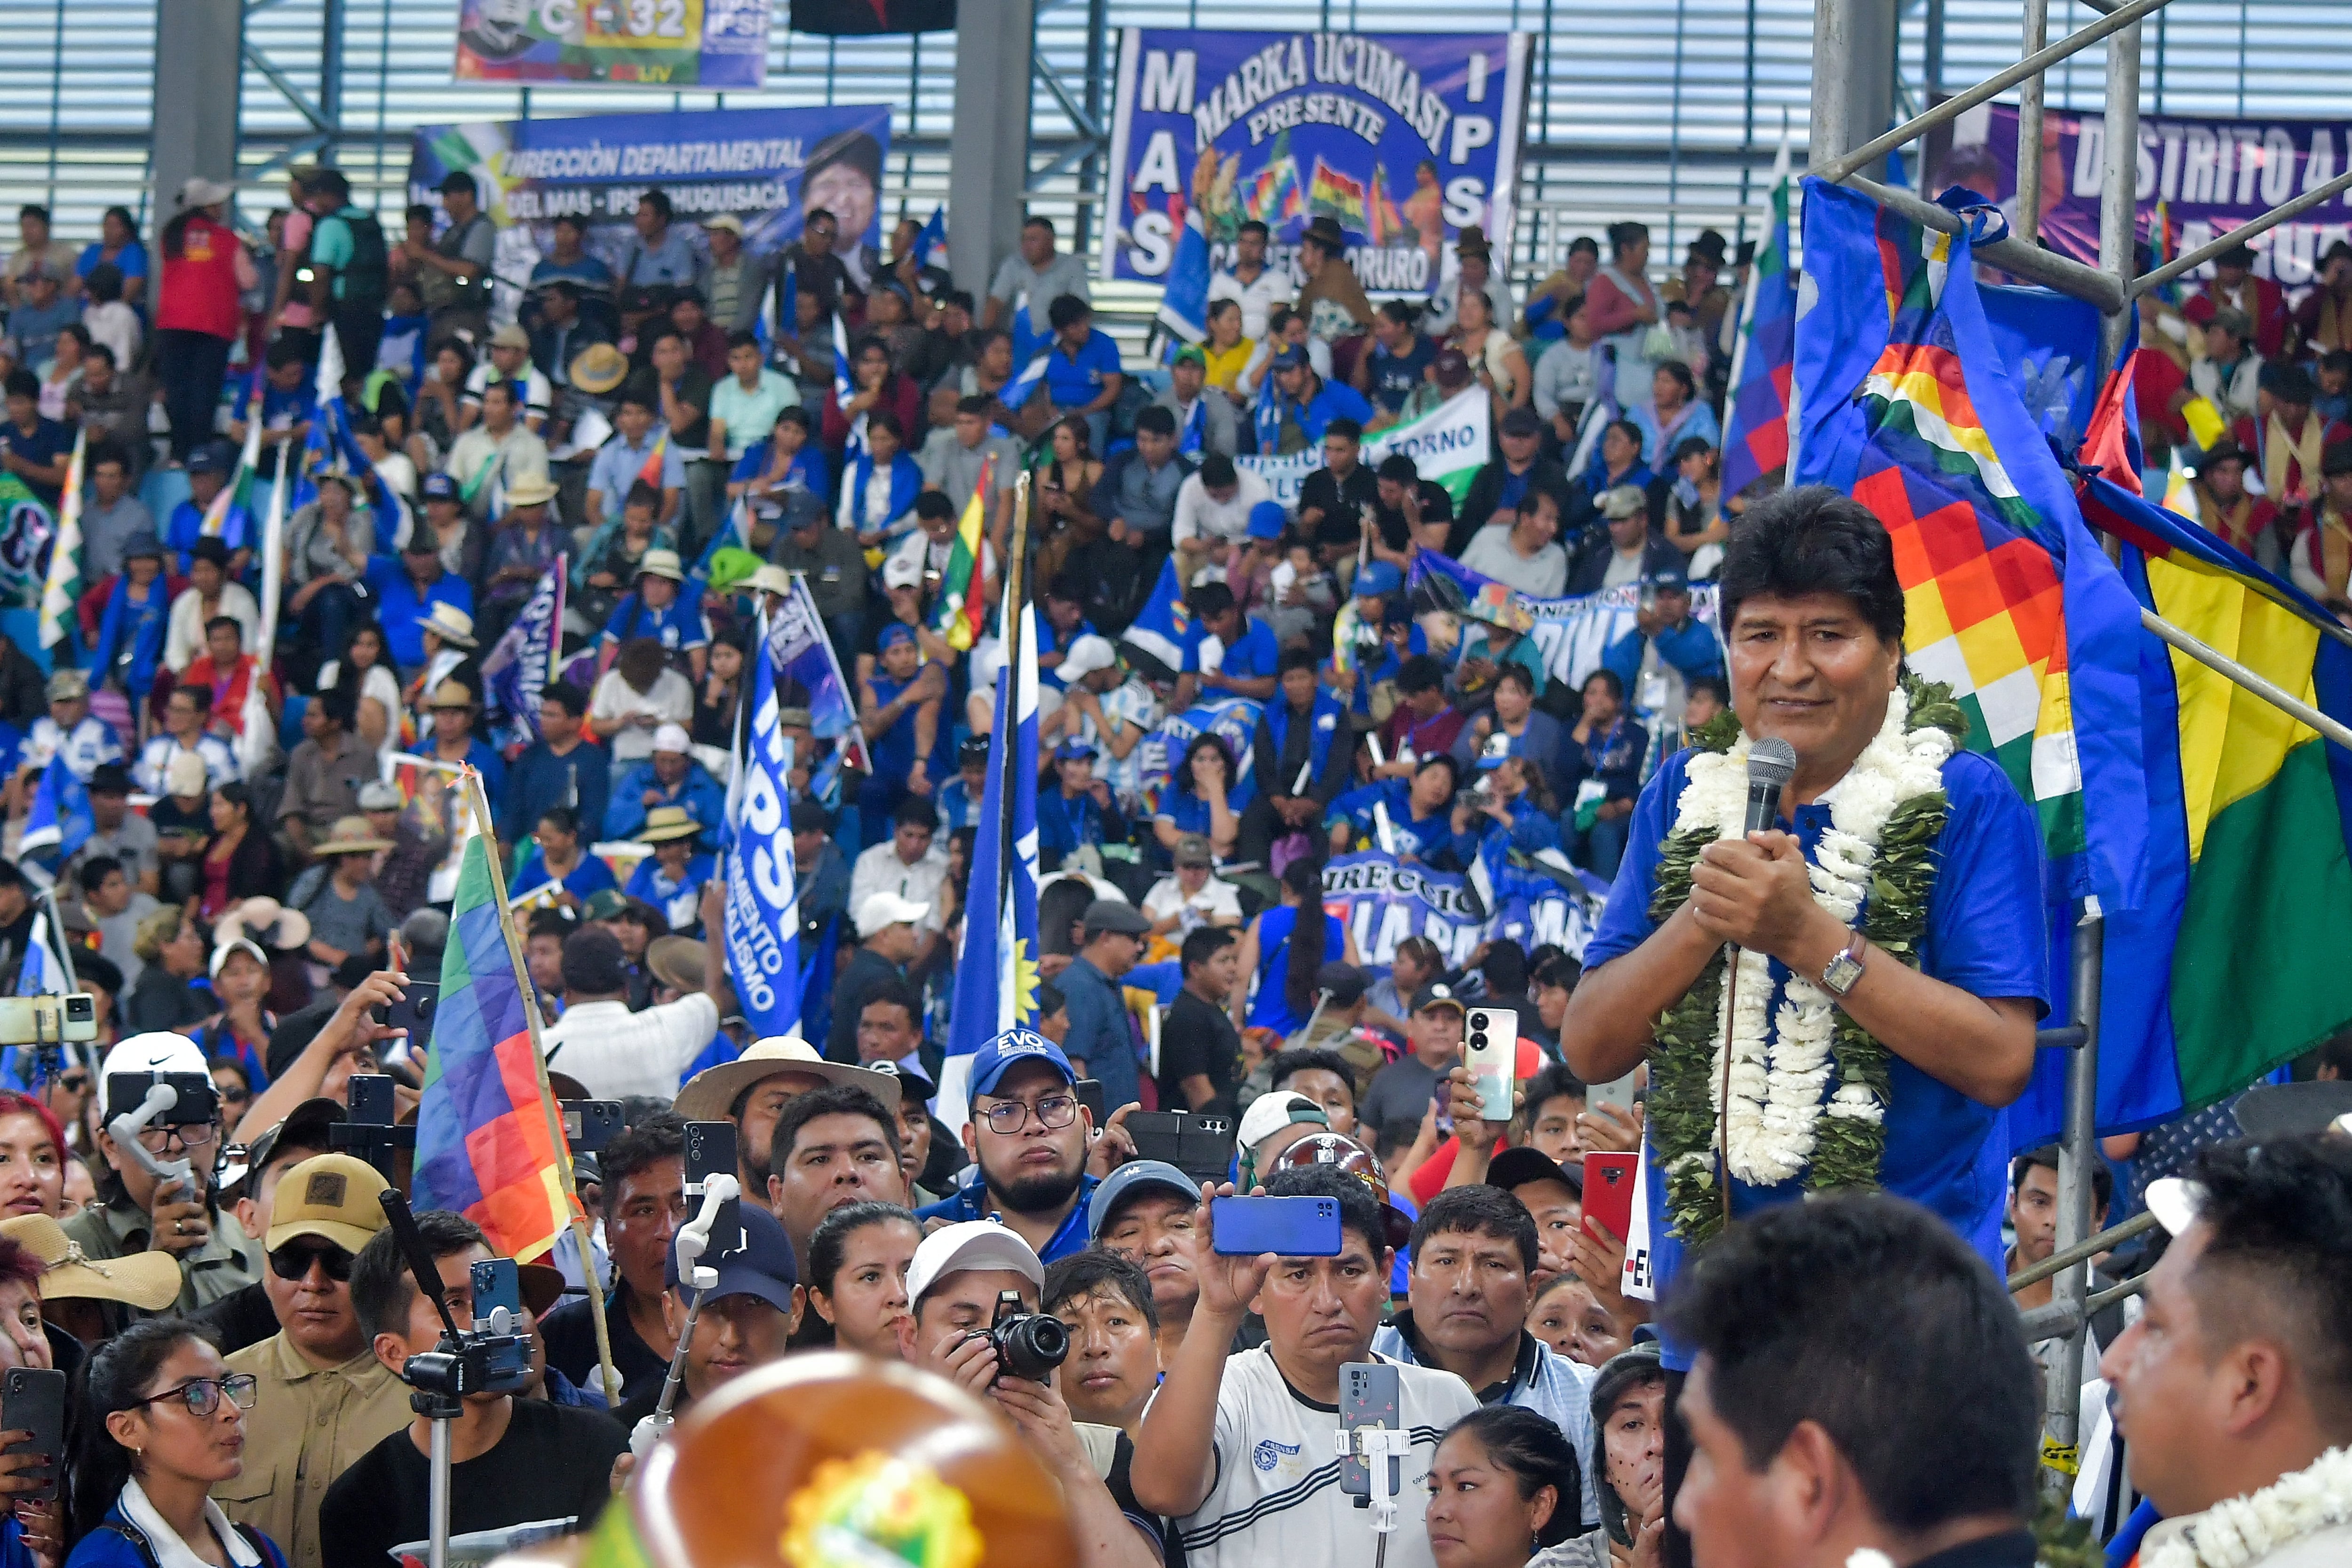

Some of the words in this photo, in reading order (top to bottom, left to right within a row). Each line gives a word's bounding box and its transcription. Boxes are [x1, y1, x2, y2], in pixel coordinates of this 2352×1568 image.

[628, 0, 686, 37] 32
[1193, 36, 1307, 154] MARKA
[1314, 33, 1451, 156] UCUMASI
[1248, 93, 1387, 146] PRESENTE
[623, 139, 803, 175] DEPARTAMENTAL
[1129, 49, 1197, 277] MAS
[2073, 117, 2296, 207] DSTRITO
[506, 190, 542, 219] DEL
[545, 189, 592, 217] MAS
[1389, 425, 1475, 460] TORNO
[1353, 900, 1411, 965] LA
[998, 1031, 1044, 1051] EVO
[1265, 1441, 1297, 1455] PRENSA
